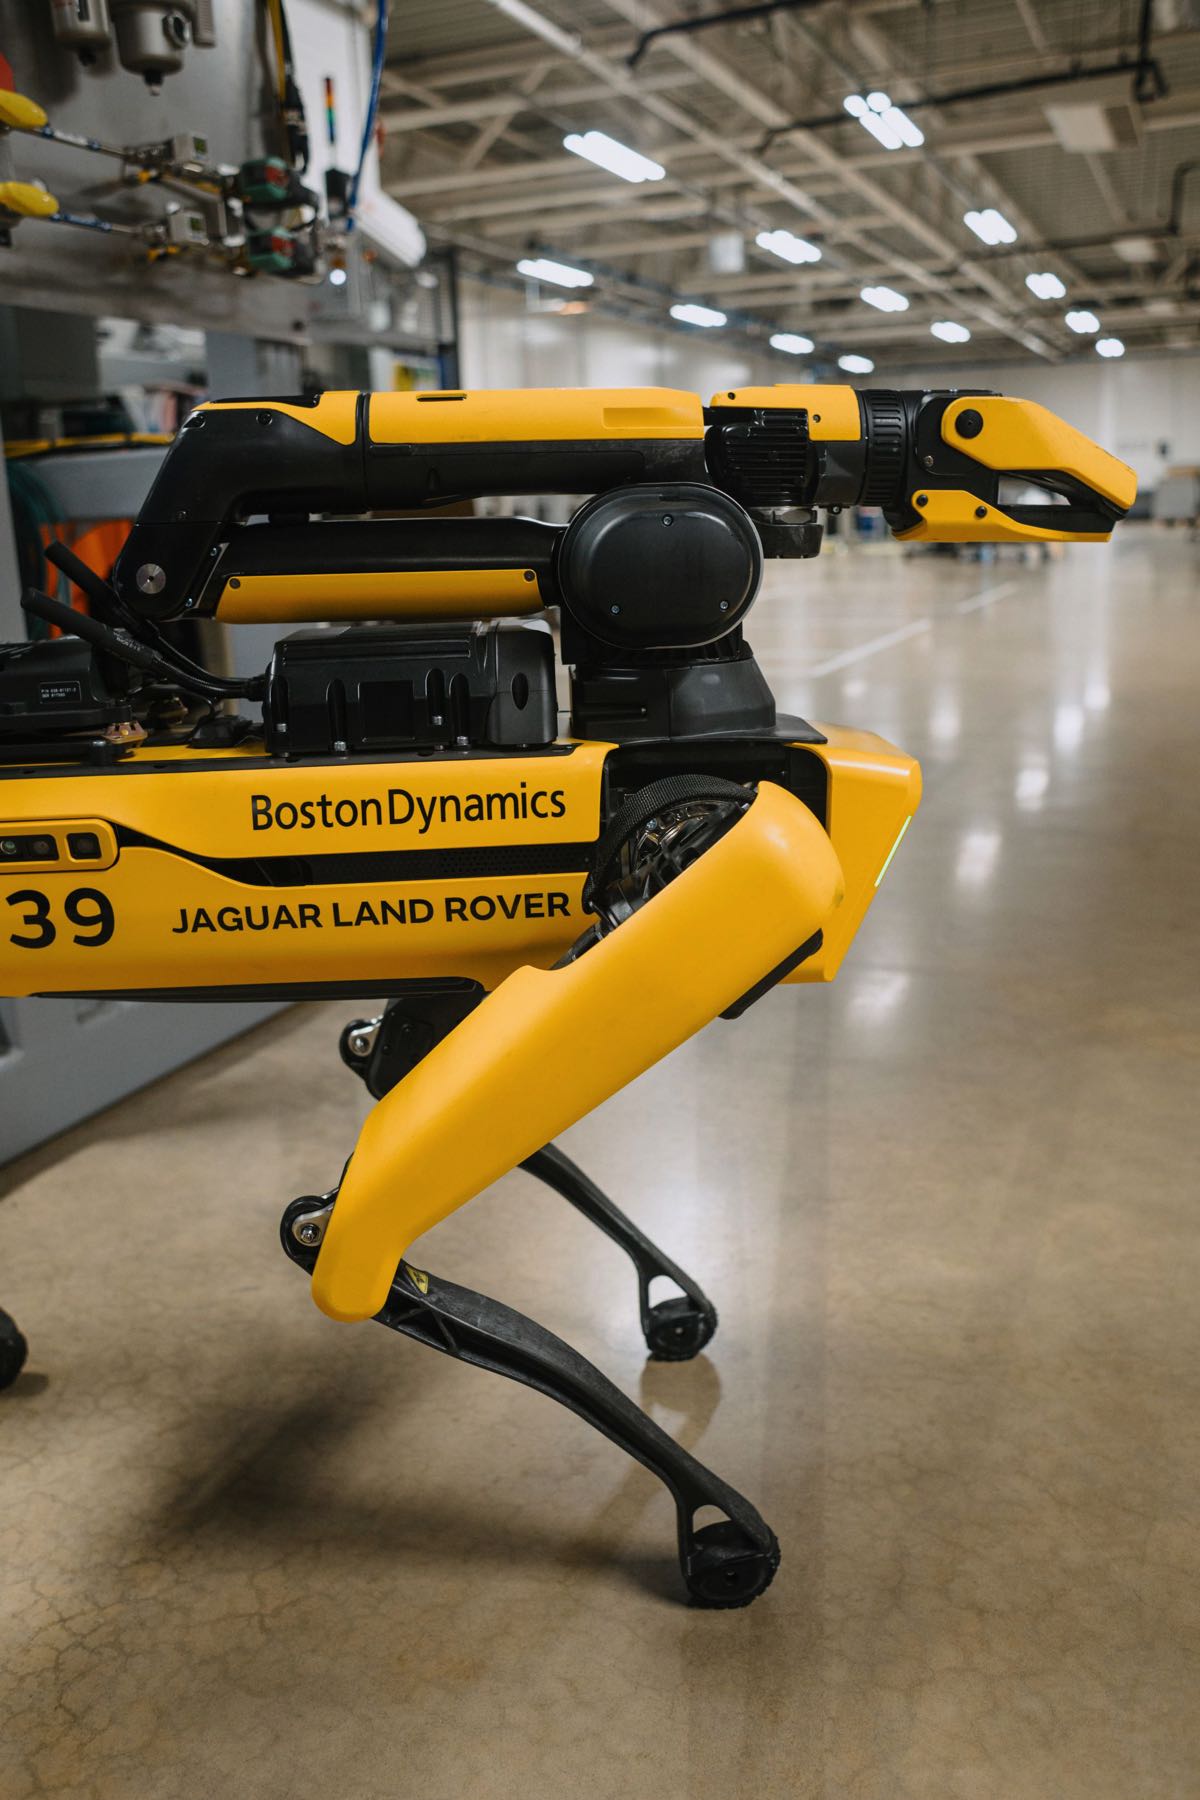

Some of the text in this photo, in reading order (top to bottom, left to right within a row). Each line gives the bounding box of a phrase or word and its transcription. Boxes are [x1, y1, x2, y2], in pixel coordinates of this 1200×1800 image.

[5, 887, 115, 950] 39
[172, 892, 571, 934] JAGUAR LAND ROVER
